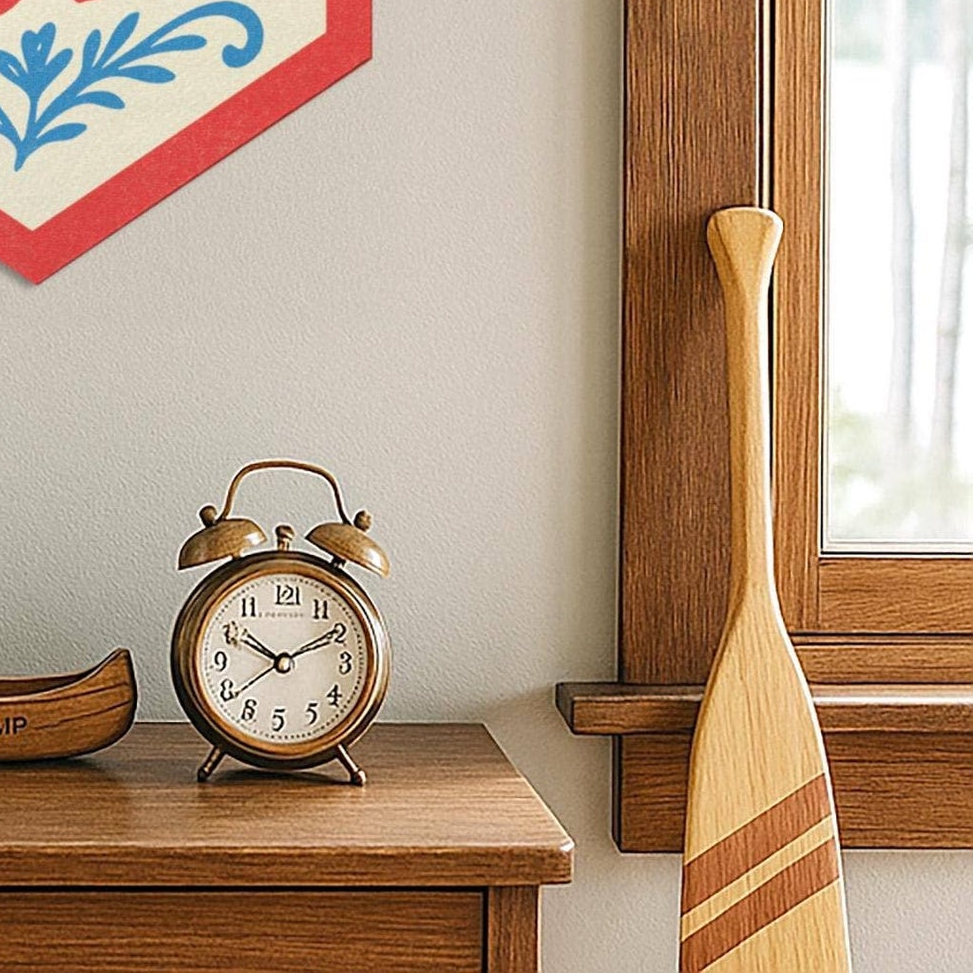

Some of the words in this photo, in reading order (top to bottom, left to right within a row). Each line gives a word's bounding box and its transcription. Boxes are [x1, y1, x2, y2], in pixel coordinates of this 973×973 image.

[214, 651, 227, 672] 9
[339, 652, 352, 674] 3
[327, 685, 342, 708] 4
[272, 709, 286, 732] 5
[306, 703, 318, 725] 5
